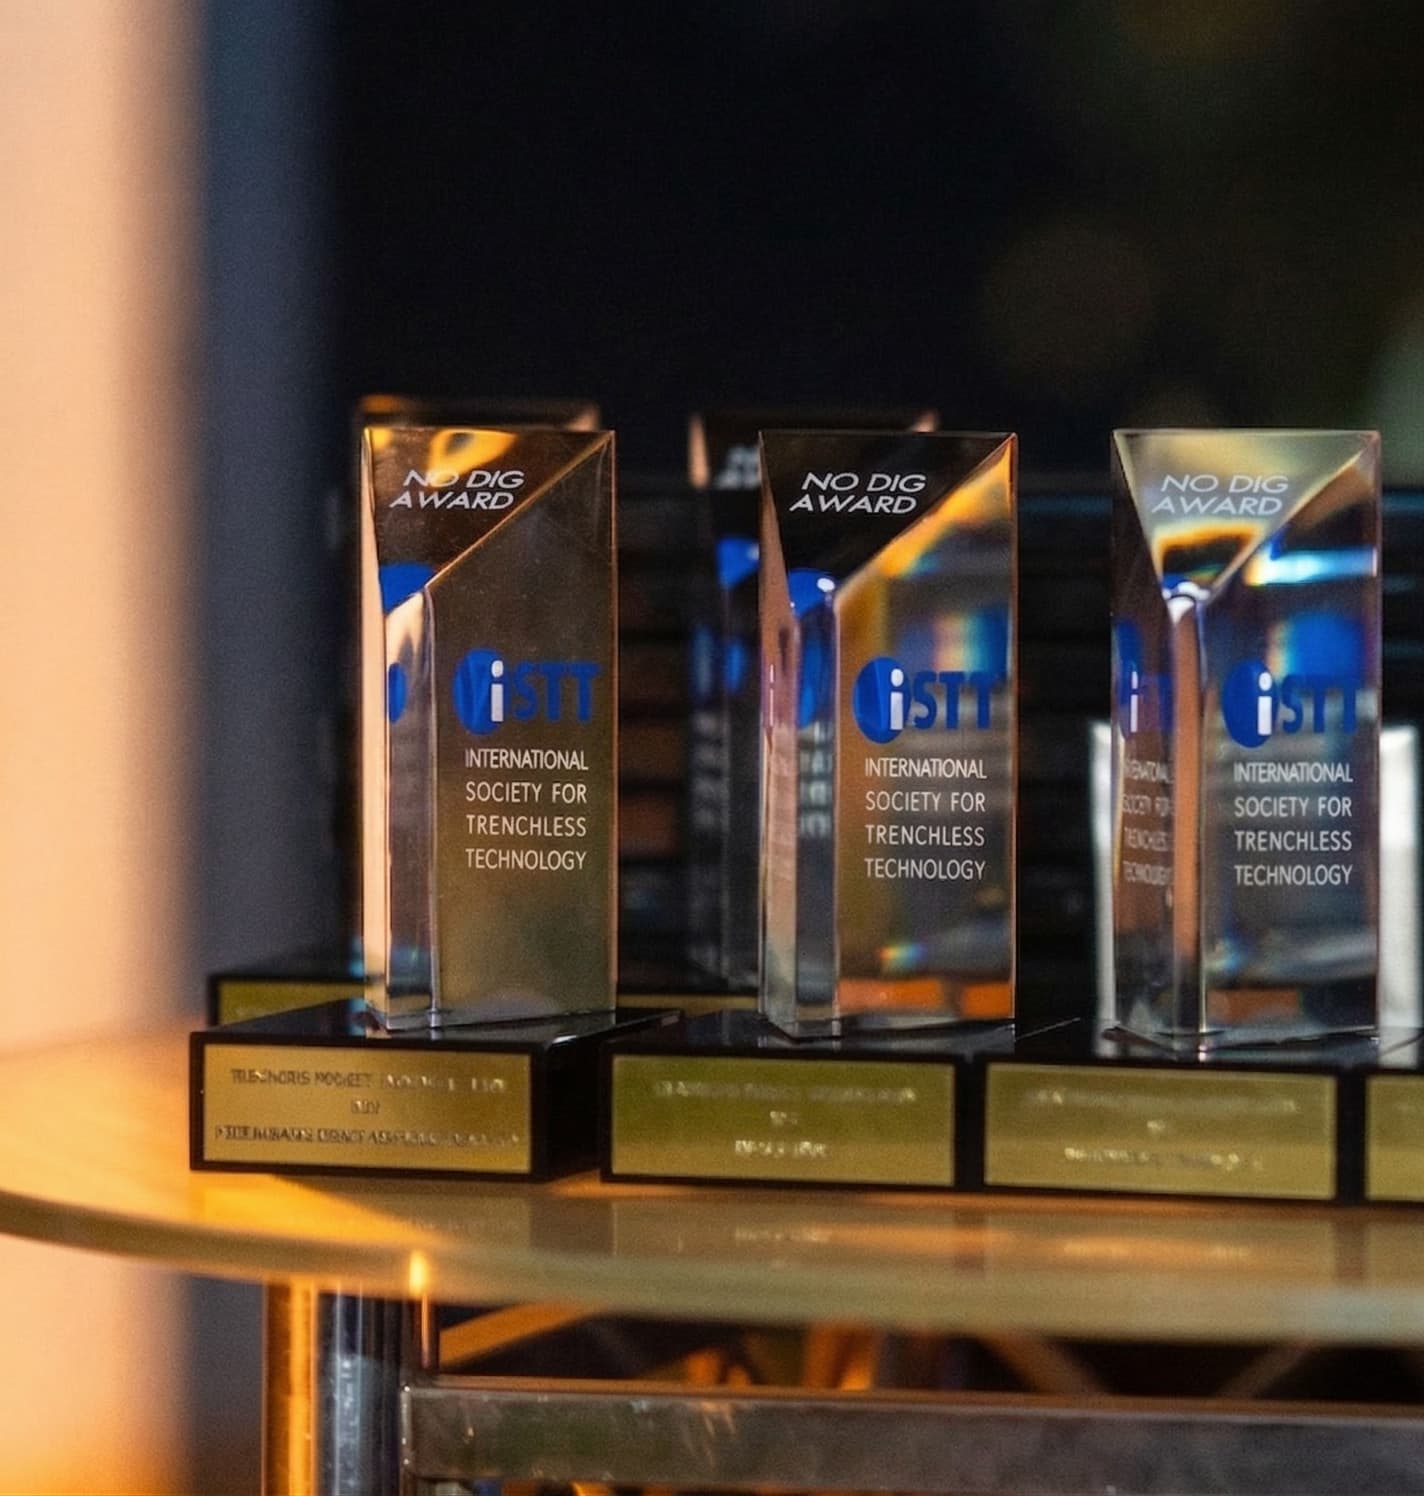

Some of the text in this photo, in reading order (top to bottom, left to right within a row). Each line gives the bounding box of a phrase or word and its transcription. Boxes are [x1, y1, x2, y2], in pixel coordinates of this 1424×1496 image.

[403, 469, 525, 489] NO DIG
[801, 473, 926, 493] NO DIG
[1160, 474, 1289, 494] NO DIG
[389, 491, 515, 509] AWARD
[789, 496, 917, 514] AWARD
[1151, 497, 1284, 515] AWARD
[465, 748, 588, 771] INTERNATIONAL
[865, 757, 987, 779] INTERNATIONAL
[1233, 762, 1353, 783] INTERNATIONAL
[465, 781, 587, 804] SOCIETY FOR
[865, 791, 986, 813] SOCIETY FOR
[1234, 796, 1352, 818] SOCIETY FOR
[466, 814, 587, 837] TRENCHLESS
[865, 825, 985, 847] TRENCHLESS
[1234, 830, 1353, 851] TRENCHLESS
[465, 848, 587, 871] TECHNOLOGY
[865, 858, 986, 881] TECHNOLOGY
[1234, 865, 1353, 886] TECHNOLOGY
